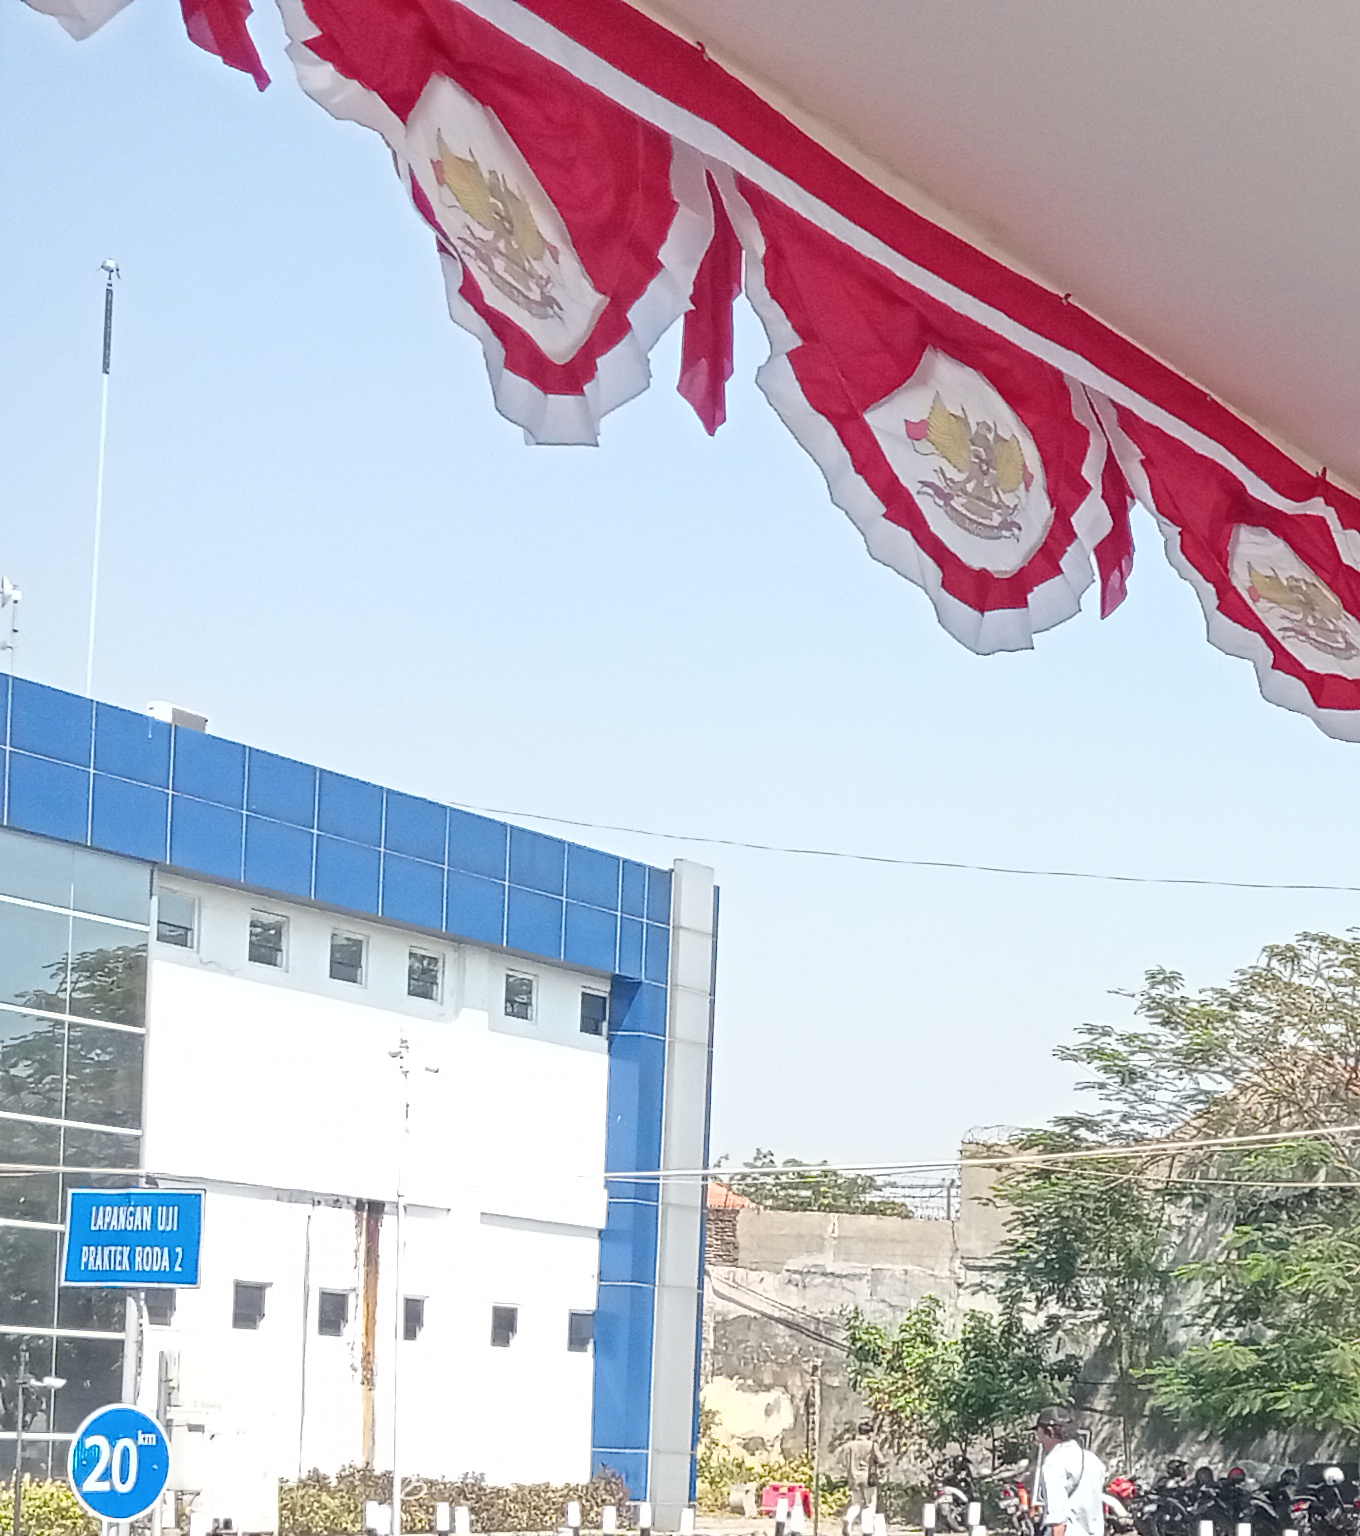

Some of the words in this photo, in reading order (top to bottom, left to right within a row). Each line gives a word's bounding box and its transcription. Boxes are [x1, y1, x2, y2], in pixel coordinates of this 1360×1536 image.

[90, 1205, 152, 1232] LAPANGAN
[157, 1205, 179, 1232] UJI
[80, 1246, 131, 1272] PRAKTEK
[135, 1246, 171, 1272] RODA
[174, 1247, 183, 1273] 2
[81, 1434, 139, 1494] 20
[137, 1429, 157, 1447] km
